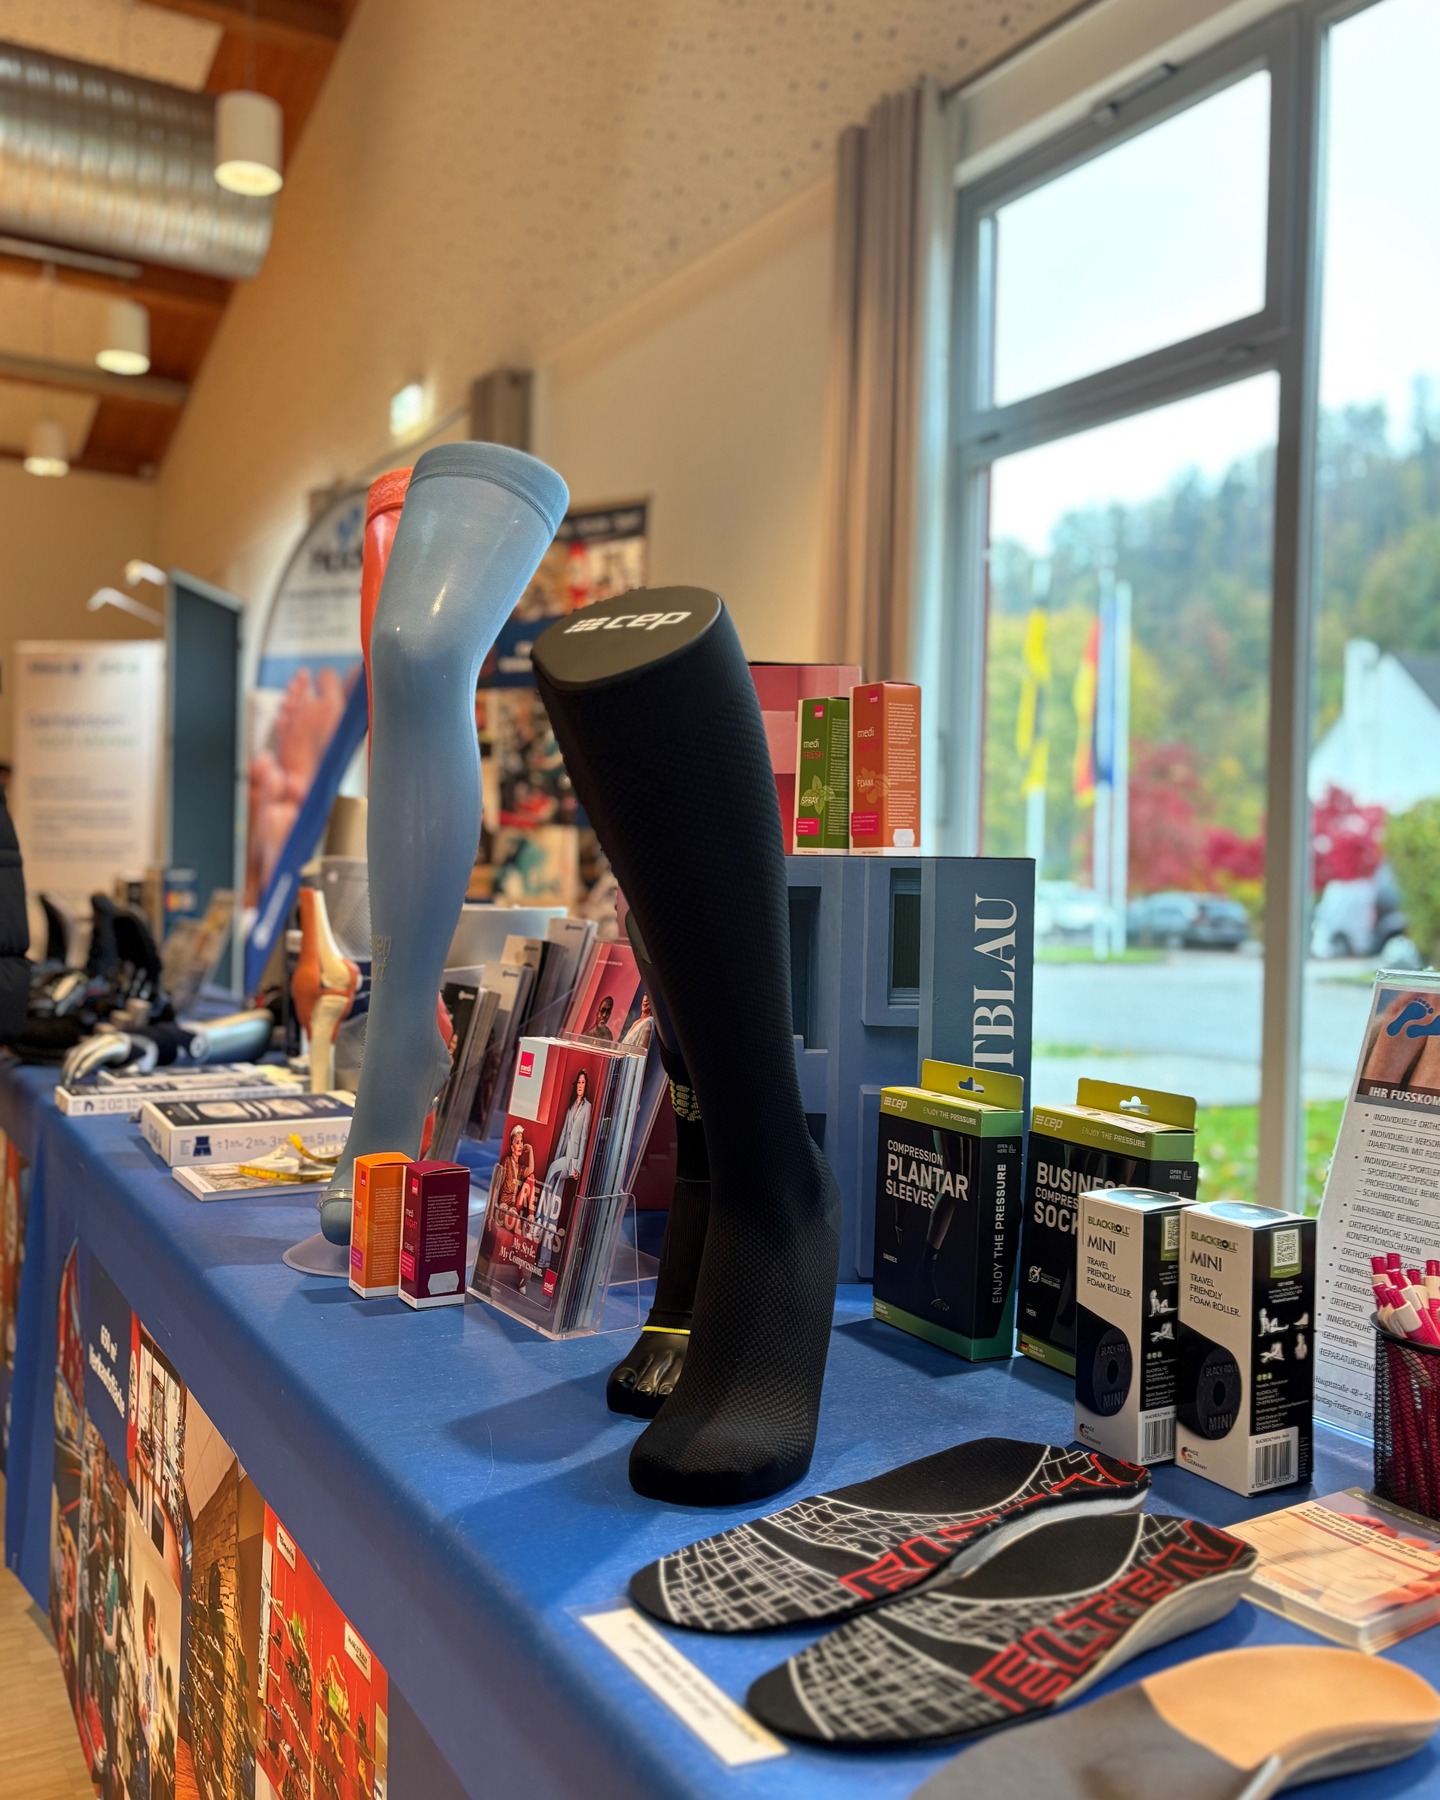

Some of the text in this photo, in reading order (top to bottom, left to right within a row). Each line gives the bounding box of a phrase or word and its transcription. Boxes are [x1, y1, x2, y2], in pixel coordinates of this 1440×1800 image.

[603, 611, 692, 631] cep
[857, 727, 874, 738] medi
[803, 738, 819, 748] medi
[856, 779, 874, 788] FOAM
[801, 796, 819, 805] SPRAY
[1369, 1086, 1389, 1098] IHR
[891, 1097, 908, 1111] cep
[923, 1106, 977, 1126] ENJOY THE PRESSURE
[1044, 1117, 1063, 1131] cep
[1081, 1126, 1146, 1149] ENJOY THE PRESSURE
[887, 1139, 943, 1166] COMPRESSION
[887, 1153, 969, 1201] PLANTAR
[1036, 1161, 1128, 1195] BUSINE
[513, 1179, 562, 1220] TREND
[886, 1179, 936, 1210] SLEEVES
[495, 1203, 565, 1254] COLOURS
[992, 1164, 1007, 1304] ENJOY THE PRESSURE
[512, 1238, 536, 1259] My Style.
[1087, 1235, 1116, 1255] MINI
[499, 1246, 543, 1278] My Compression.
[1087, 1256, 1109, 1270] TRAVEL
[1190, 1250, 1222, 1272] MINI
[1086, 1277, 1106, 1290] FOAM
[1087, 1266, 1116, 1282] FRIENDLY
[1190, 1273, 1215, 1288] TRAVEL
[1189, 1294, 1212, 1309] FOAM
[1190, 1284, 1223, 1300] FRIENDLY
[1103, 1390, 1125, 1409] MINI
[1208, 1413, 1233, 1432] MINI
[1328, 1513, 1362, 1530] möchten
[1347, 1526, 1373, 1541] Events
[971, 1519, 1246, 1713] ELTEN
